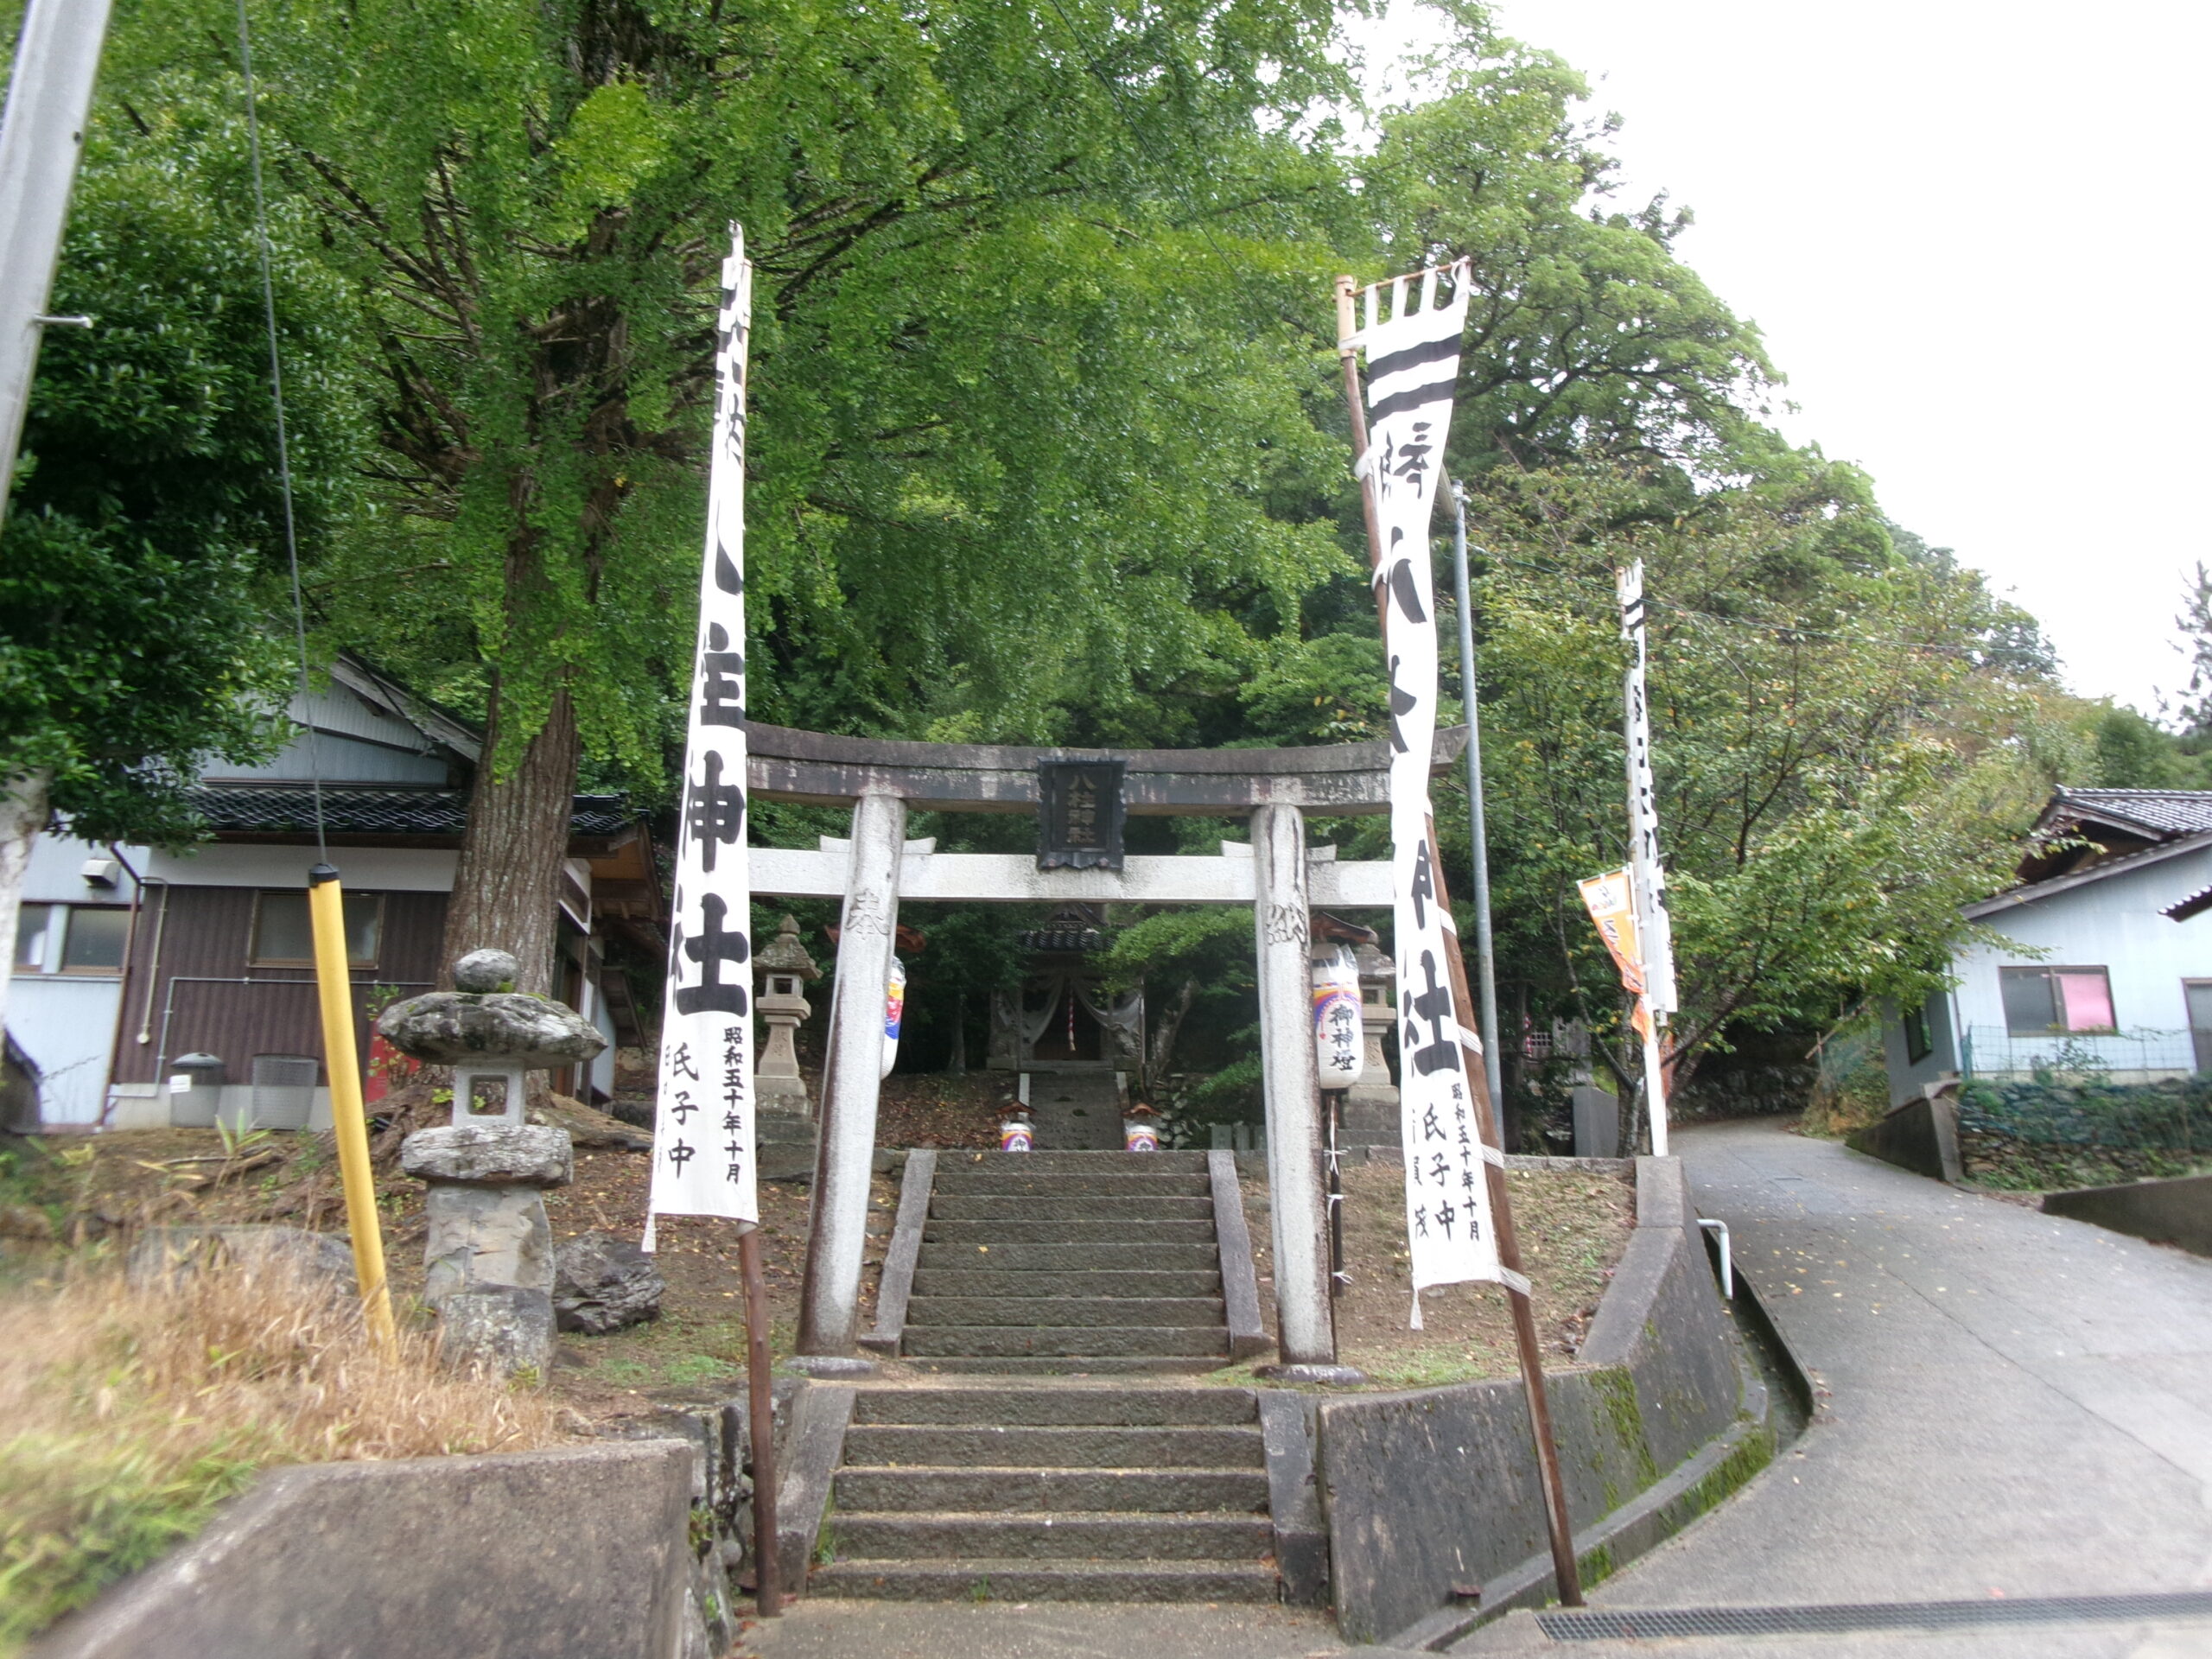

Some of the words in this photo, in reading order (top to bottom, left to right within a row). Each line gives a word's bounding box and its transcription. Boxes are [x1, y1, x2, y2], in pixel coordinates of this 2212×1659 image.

[846, 887, 890, 940] 奉
[669, 1042, 700, 1179] 氏子中
[723, 1027, 744, 1185] 昭和五十年十月
[1423, 1103, 1455, 1242] 氏子中
[1451, 1083, 1479, 1242] 昭和五十年十月
